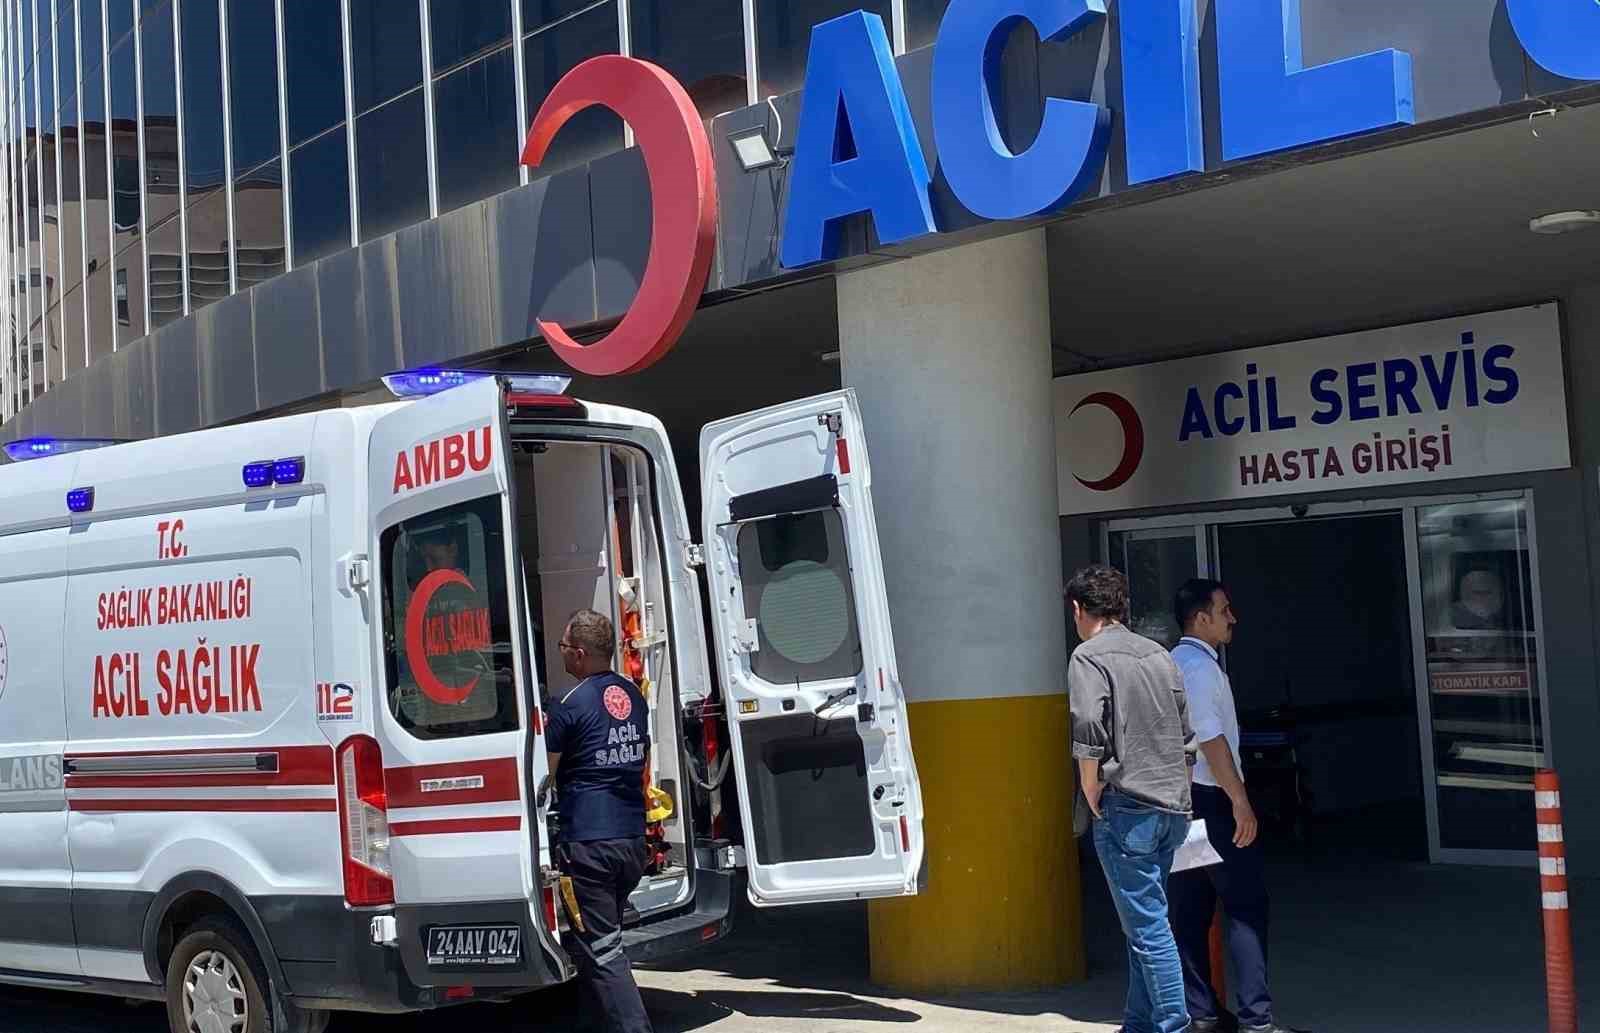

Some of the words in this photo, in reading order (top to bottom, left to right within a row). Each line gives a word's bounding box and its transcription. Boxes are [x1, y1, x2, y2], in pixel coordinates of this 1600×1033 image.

[1178, 364, 1296, 442] ACİL
[1310, 331, 1520, 426] SERVİS
[393, 425, 492, 494] AMBU
[1240, 446, 1344, 487] HASTA
[1352, 424, 1453, 474] GİRİŞİ
[157, 519, 188, 559] T.C.
[97, 585, 152, 630] SAĞLIK
[157, 573, 251, 625] BAKANLIĞI
[156, 636, 262, 717] SAĞLIK
[317, 683, 354, 714] 112
[488, 929, 517, 954] 047
